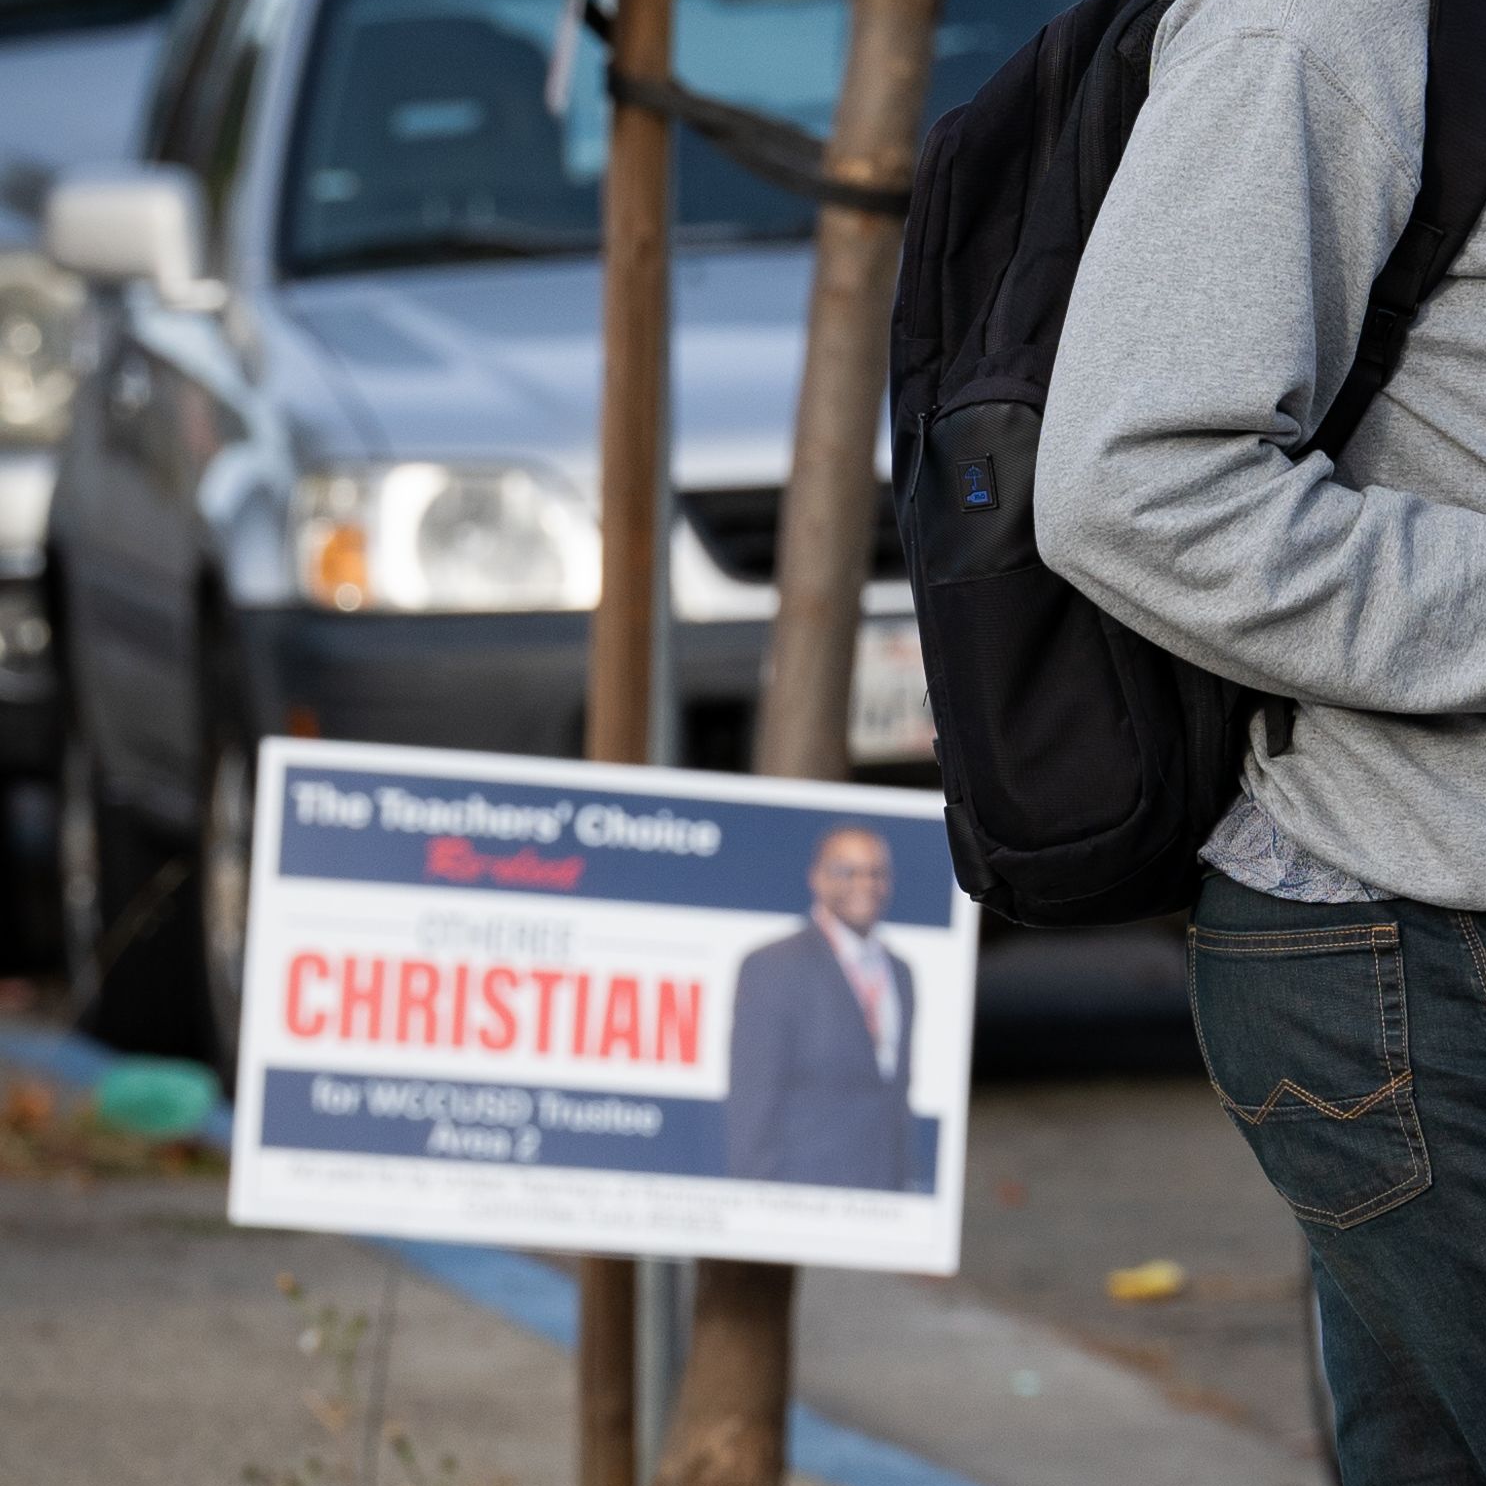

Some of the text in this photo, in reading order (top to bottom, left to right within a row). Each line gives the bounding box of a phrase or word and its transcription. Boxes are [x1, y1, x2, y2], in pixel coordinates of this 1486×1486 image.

[292, 782, 720, 856] The Teachers' Choice
[286, 951, 705, 1066] CHRISTIAN
[312, 1075, 360, 1113] for
[539, 1090, 662, 1136] Trustee
[429, 1117, 541, 1162] Area 2
